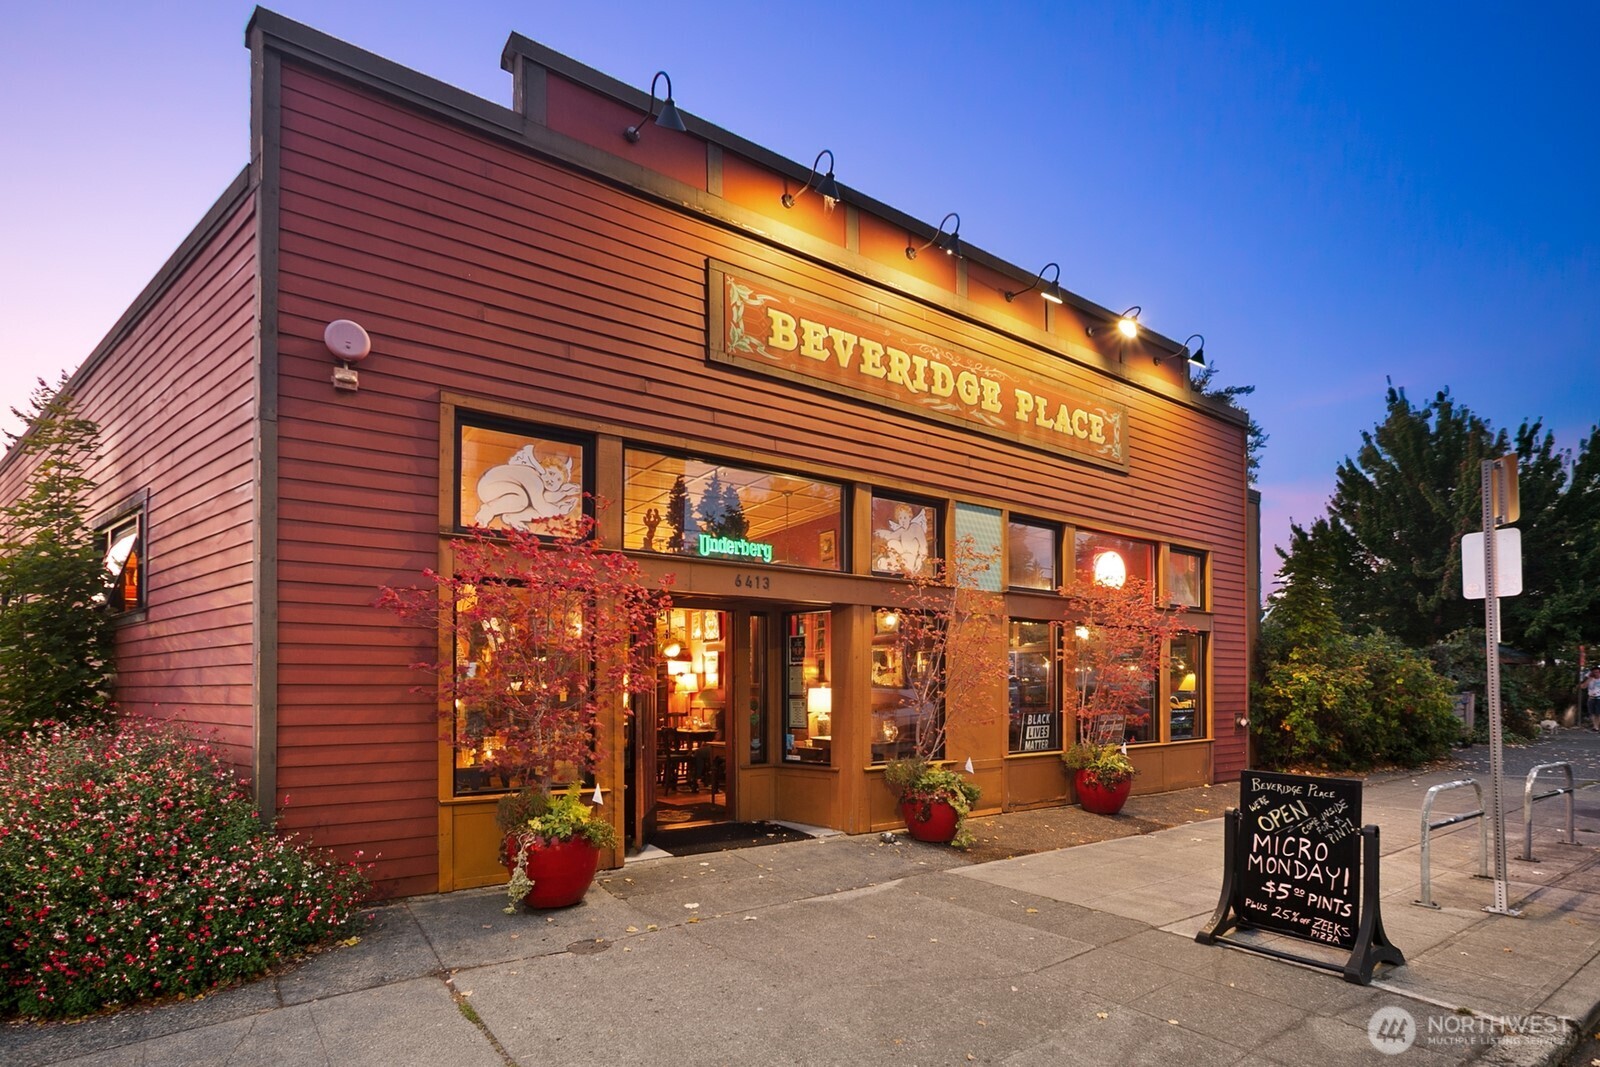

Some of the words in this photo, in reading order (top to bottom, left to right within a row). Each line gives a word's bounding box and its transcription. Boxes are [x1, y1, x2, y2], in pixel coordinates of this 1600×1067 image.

[766, 307, 1002, 414] BEVERIDGE
[1014, 388, 1107, 445] PLACE
[699, 534, 773, 563] Underberg
[735, 574, 770, 590] 6413
[1027, 713, 1050, 725] BLACK
[1024, 739, 1049, 751] MATTER
[1028, 727, 1048, 738] LIVES
[1251, 777, 1303, 796] BEVERIDGE
[1307, 783, 1336, 799] PLACE
[1257, 799, 1309, 832] OPEN
[1301, 816, 1321, 835] COME
[1320, 798, 1349, 821] INSIDE
[1316, 821, 1334, 835] FOR
[1325, 817, 1356, 845] PINT!
[1252, 833, 1329, 862] MICRO
[1247, 853, 1350, 896] MONDAY!
[1245, 898, 1268, 911] PLUS
[1271, 906, 1300, 922] 25%
[1312, 917, 1351, 937] ZEEKS
[1307, 893, 1353, 917] PINTS
[1310, 929, 1340, 944] PIZZA
